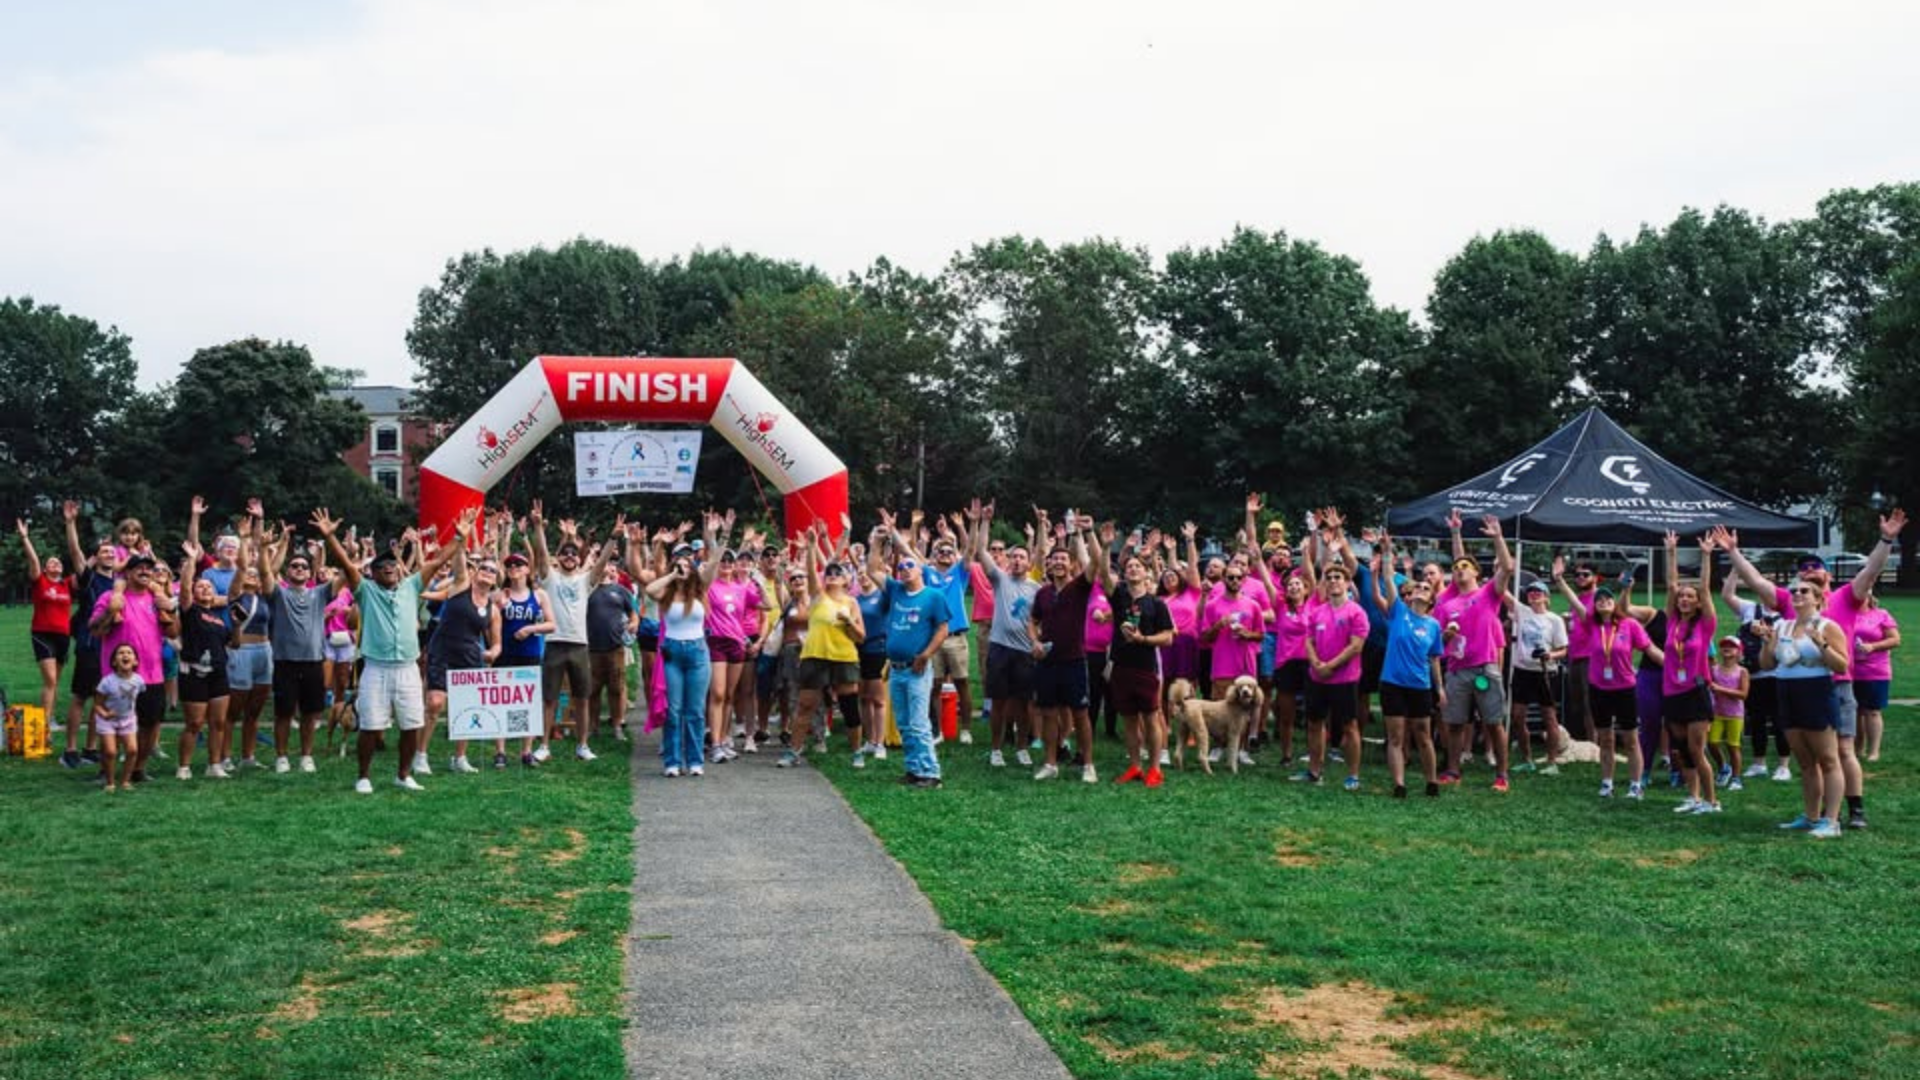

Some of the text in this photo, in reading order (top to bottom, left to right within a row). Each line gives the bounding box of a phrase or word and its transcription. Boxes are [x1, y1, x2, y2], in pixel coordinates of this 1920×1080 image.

[567, 371, 707, 403] FINISH
[478, 411, 539, 470] HighSEM
[735, 413, 796, 471] HighSEM
[1562, 496, 1737, 511] COGNATI ELECTRIC
[505, 605, 533, 621] USA
[451, 670, 499, 686] DONATE
[477, 684, 536, 705] TODAY
